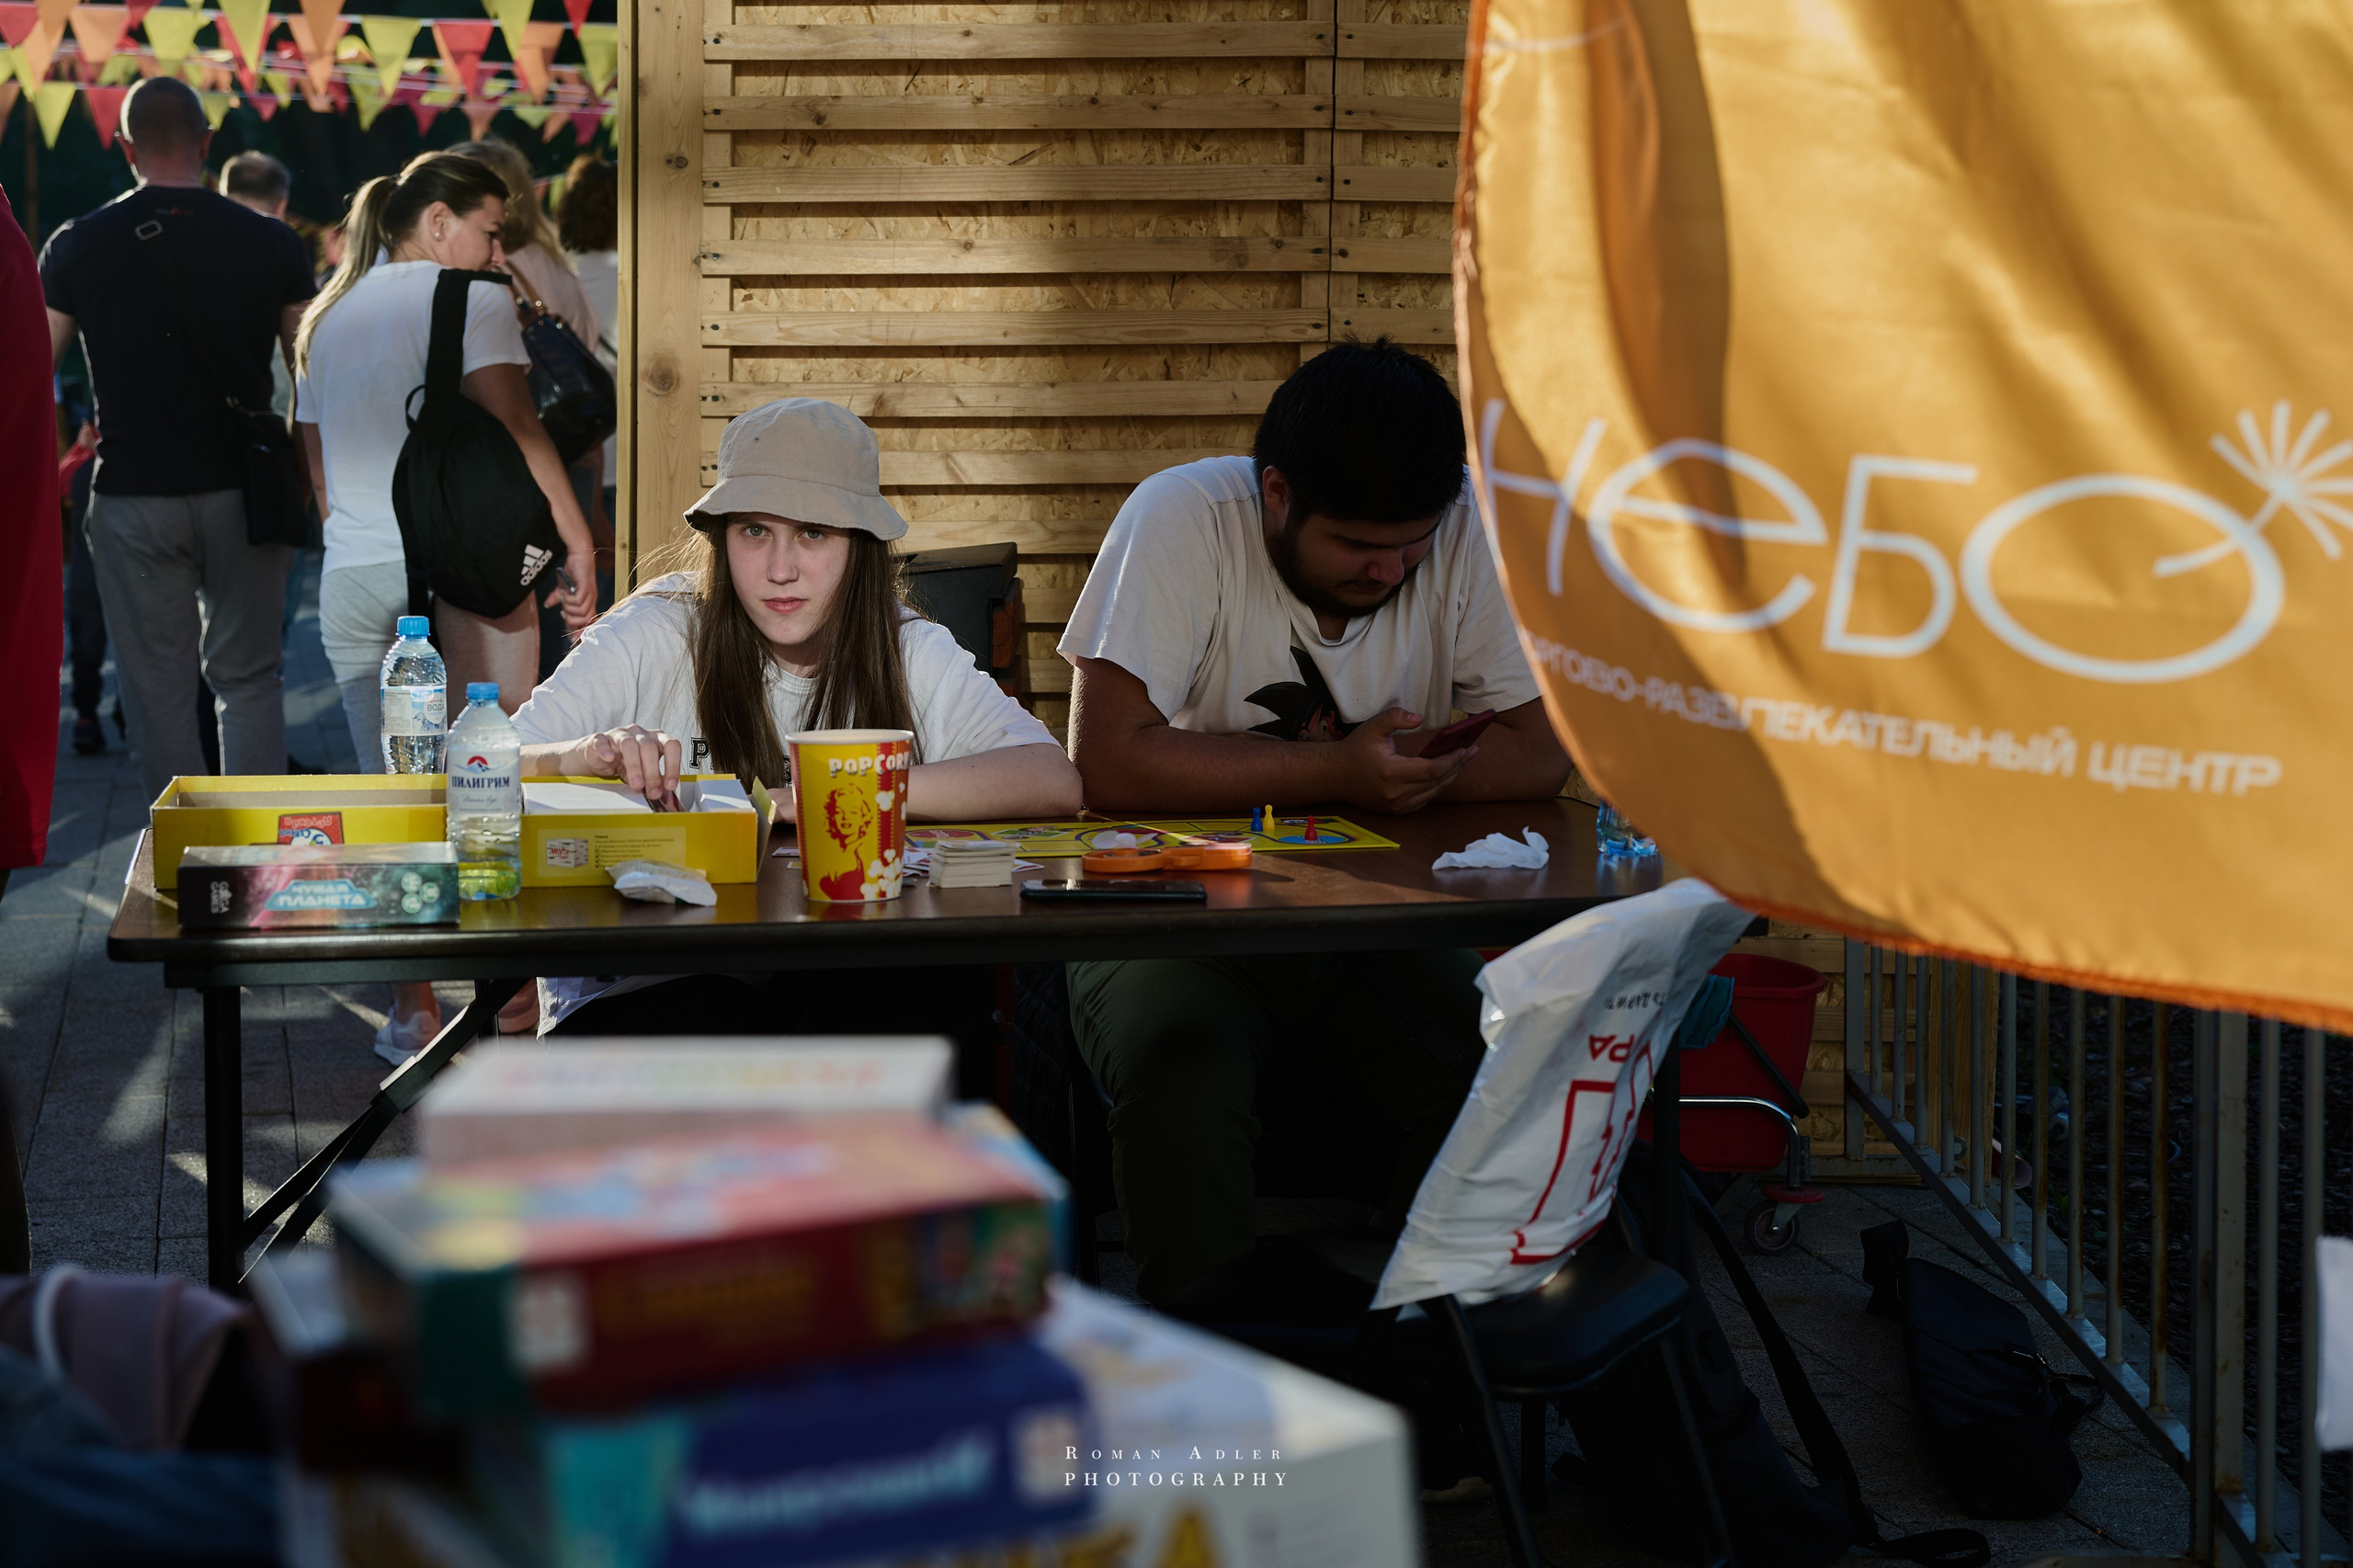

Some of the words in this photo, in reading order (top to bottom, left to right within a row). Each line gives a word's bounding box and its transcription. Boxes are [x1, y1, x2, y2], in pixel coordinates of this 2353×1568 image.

[520, 550, 553, 586] adidas
[2086, 741, 2282, 796] ЦЕНТР
[451, 776, 510, 789] ПИЛИГРИМ
[278, 894, 366, 906] ПЛАНЕТА
